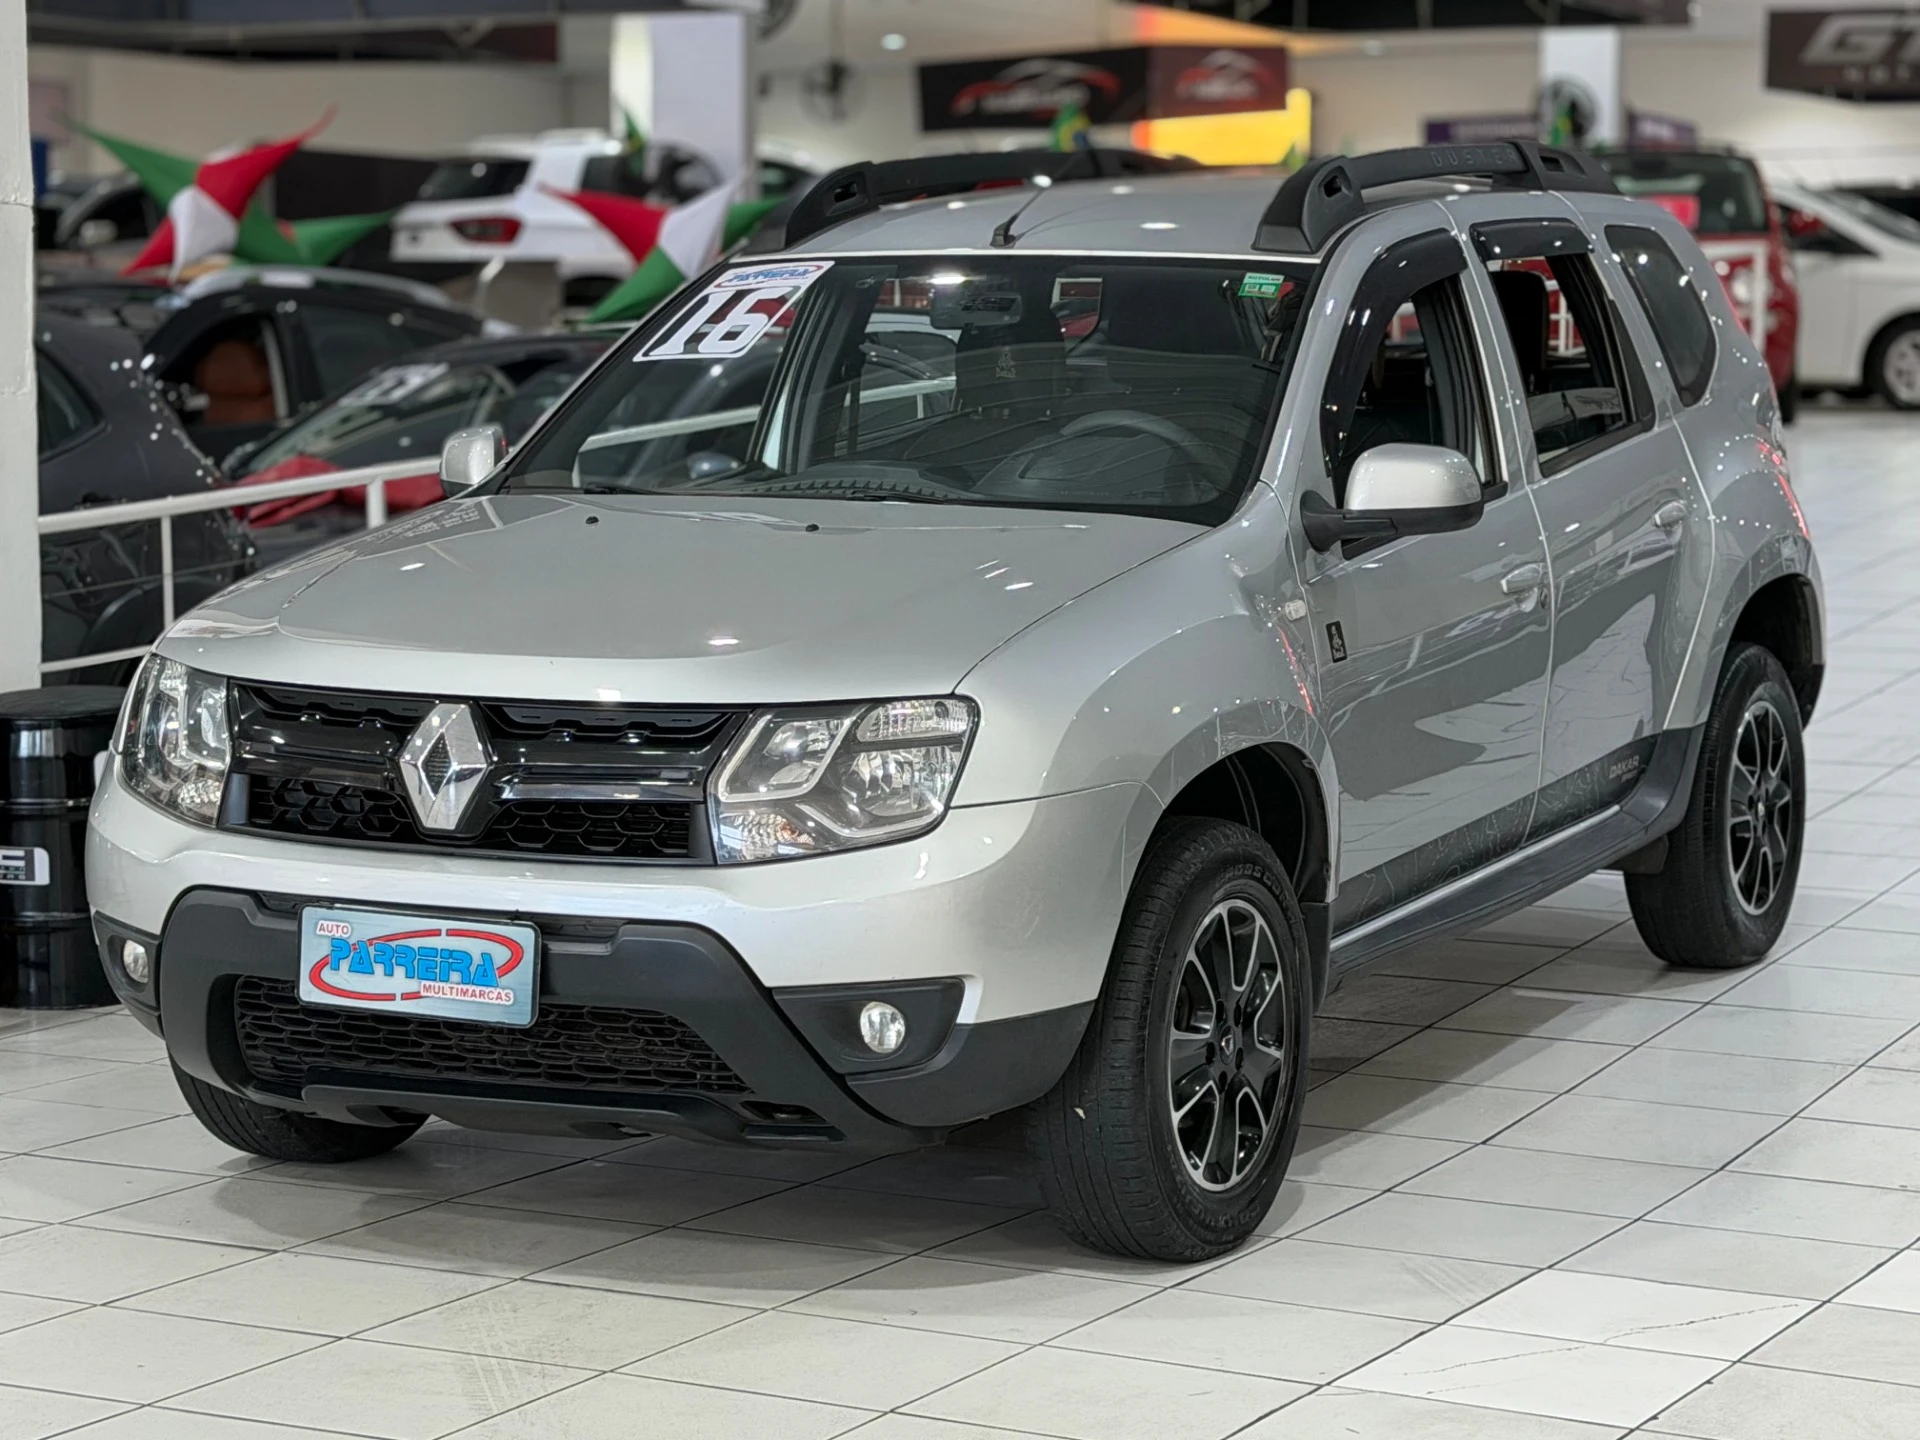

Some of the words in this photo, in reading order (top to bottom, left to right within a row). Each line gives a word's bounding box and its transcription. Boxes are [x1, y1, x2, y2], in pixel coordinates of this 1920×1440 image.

[1430, 148, 1519, 168] DUSTER
[649, 287, 793, 354] 16
[1609, 756, 1639, 779] DAKAR
[318, 923, 350, 935] AUTO
[330, 938, 499, 988] PARREIRA
[422, 984, 513, 1003] MULTIMARCAS
